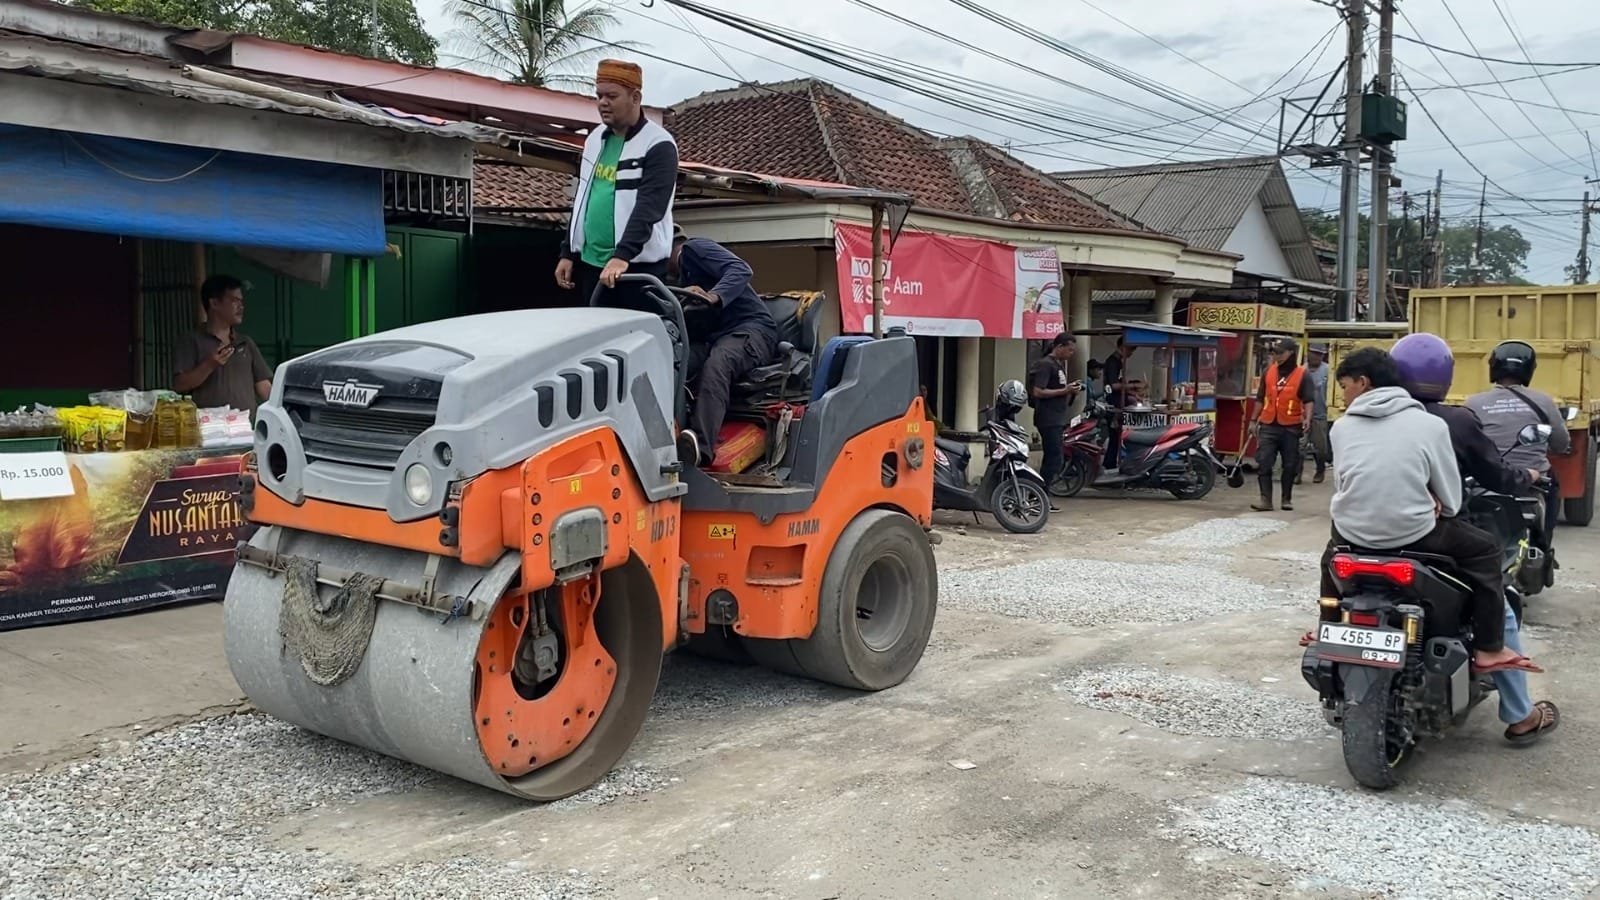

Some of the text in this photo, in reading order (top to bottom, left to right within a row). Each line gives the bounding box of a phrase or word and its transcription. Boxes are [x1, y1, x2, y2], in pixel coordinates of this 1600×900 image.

[596, 163, 616, 182] RAZ
[855, 259, 888, 277] TOO
[865, 284, 891, 305] SC
[893, 276, 923, 296] Aam
[1194, 307, 1255, 325] KEBAB
[328, 386, 368, 404] HAMM
[0, 466, 64, 480] Rp. 15.000
[181, 488, 232, 510] Surya
[149, 501, 248, 537] NUSANTA
[787, 518, 820, 538] HAMM
[180, 532, 235, 547] RAYA
[16, 610, 43, 620] KANKER
[94, 599, 121, 609] LAYANAN
[1322, 626, 1329, 640] A
[1340, 629, 1373, 645] 4565
